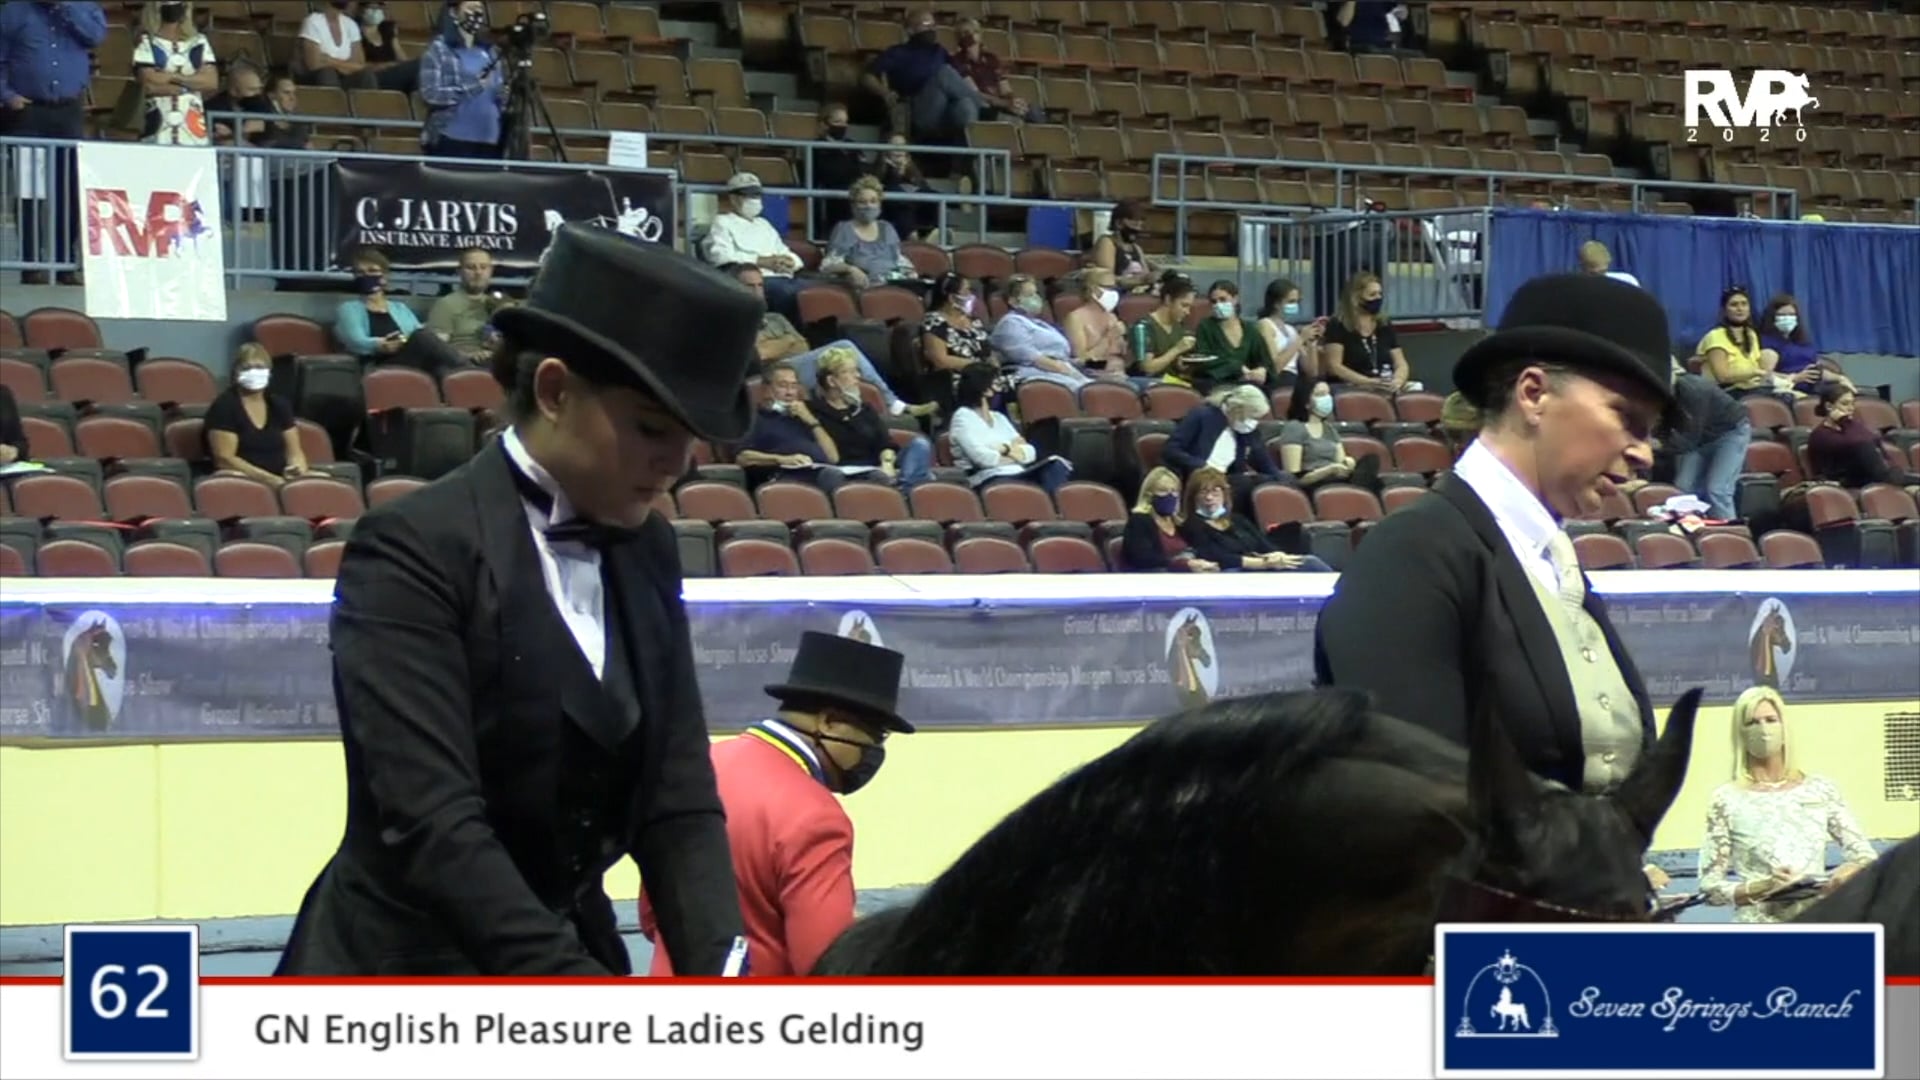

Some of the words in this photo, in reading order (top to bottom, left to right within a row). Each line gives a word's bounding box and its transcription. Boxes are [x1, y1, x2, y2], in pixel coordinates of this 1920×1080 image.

[86, 188, 200, 258] RVP
[355, 196, 385, 231] C.
[393, 198, 519, 235] JARVIS
[359, 230, 451, 249] INSURANCE
[454, 233, 517, 252] AGENCY
[995, 664, 1069, 691] Championship
